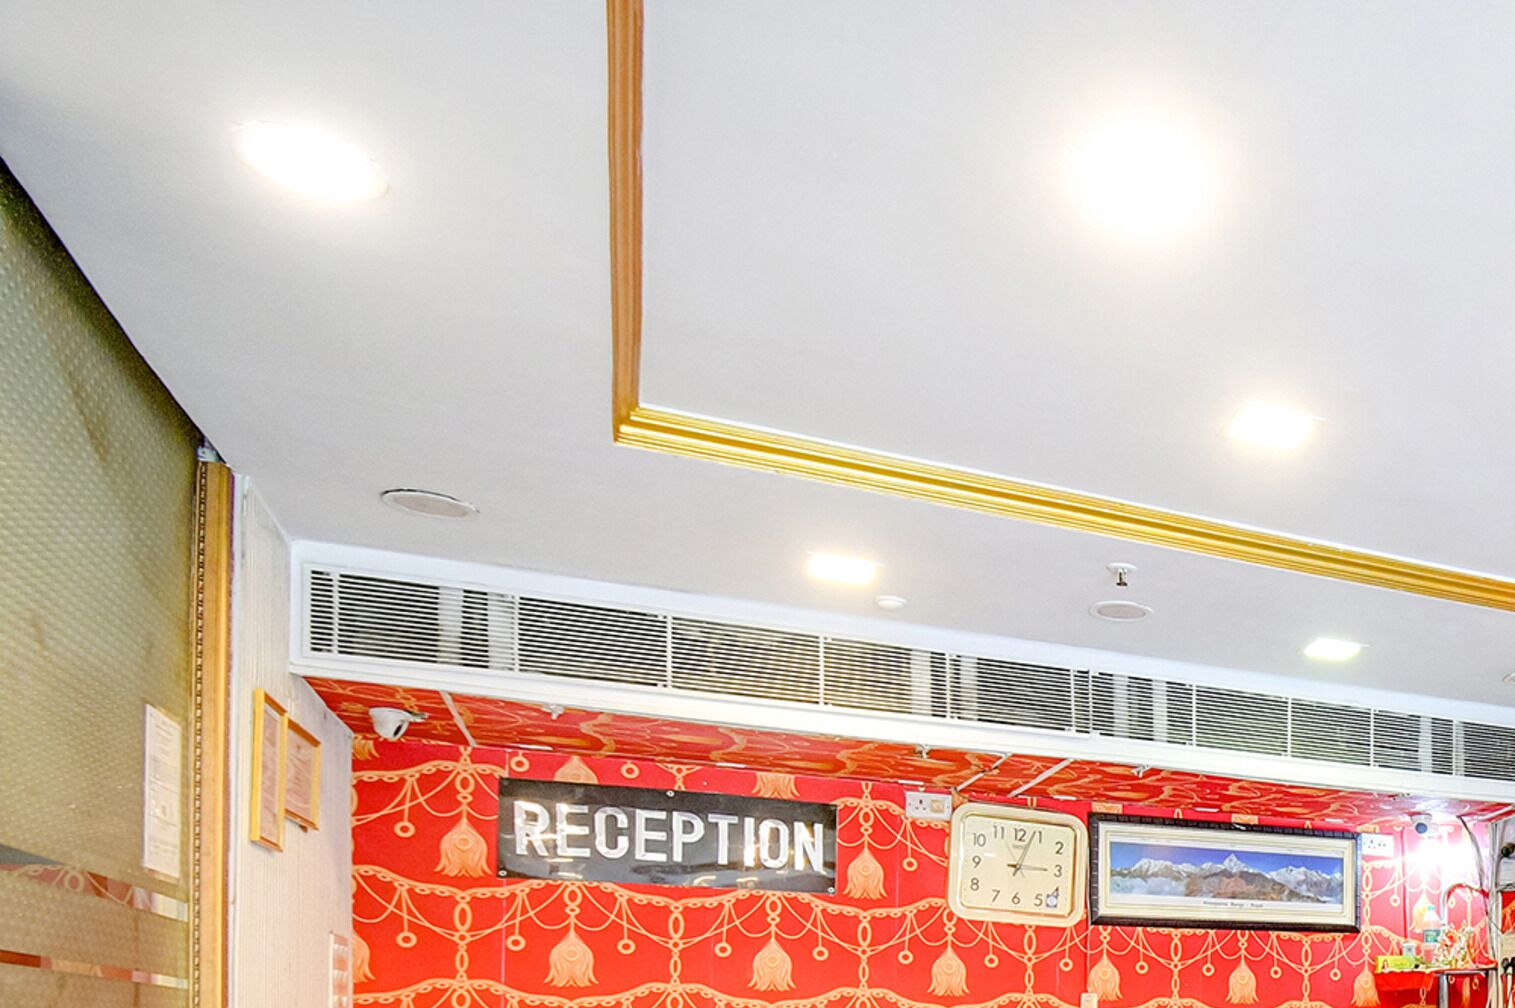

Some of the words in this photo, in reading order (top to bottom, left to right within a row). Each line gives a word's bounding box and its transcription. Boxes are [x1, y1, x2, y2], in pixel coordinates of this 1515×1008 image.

[513, 800, 826, 873] RECEPTION
[973, 832, 987, 847] 10
[993, 825, 1005, 840] 11
[1014, 827, 1027, 843] 12
[1038, 831, 1043, 844] 1
[1055, 841, 1064, 855] 2
[972, 855, 982, 868] 9
[1053, 864, 1063, 878] 3
[970, 877, 980, 891] 8
[991, 889, 1001, 903] 7
[1011, 892, 1021, 905] 6
[1034, 893, 1043, 907] 5
